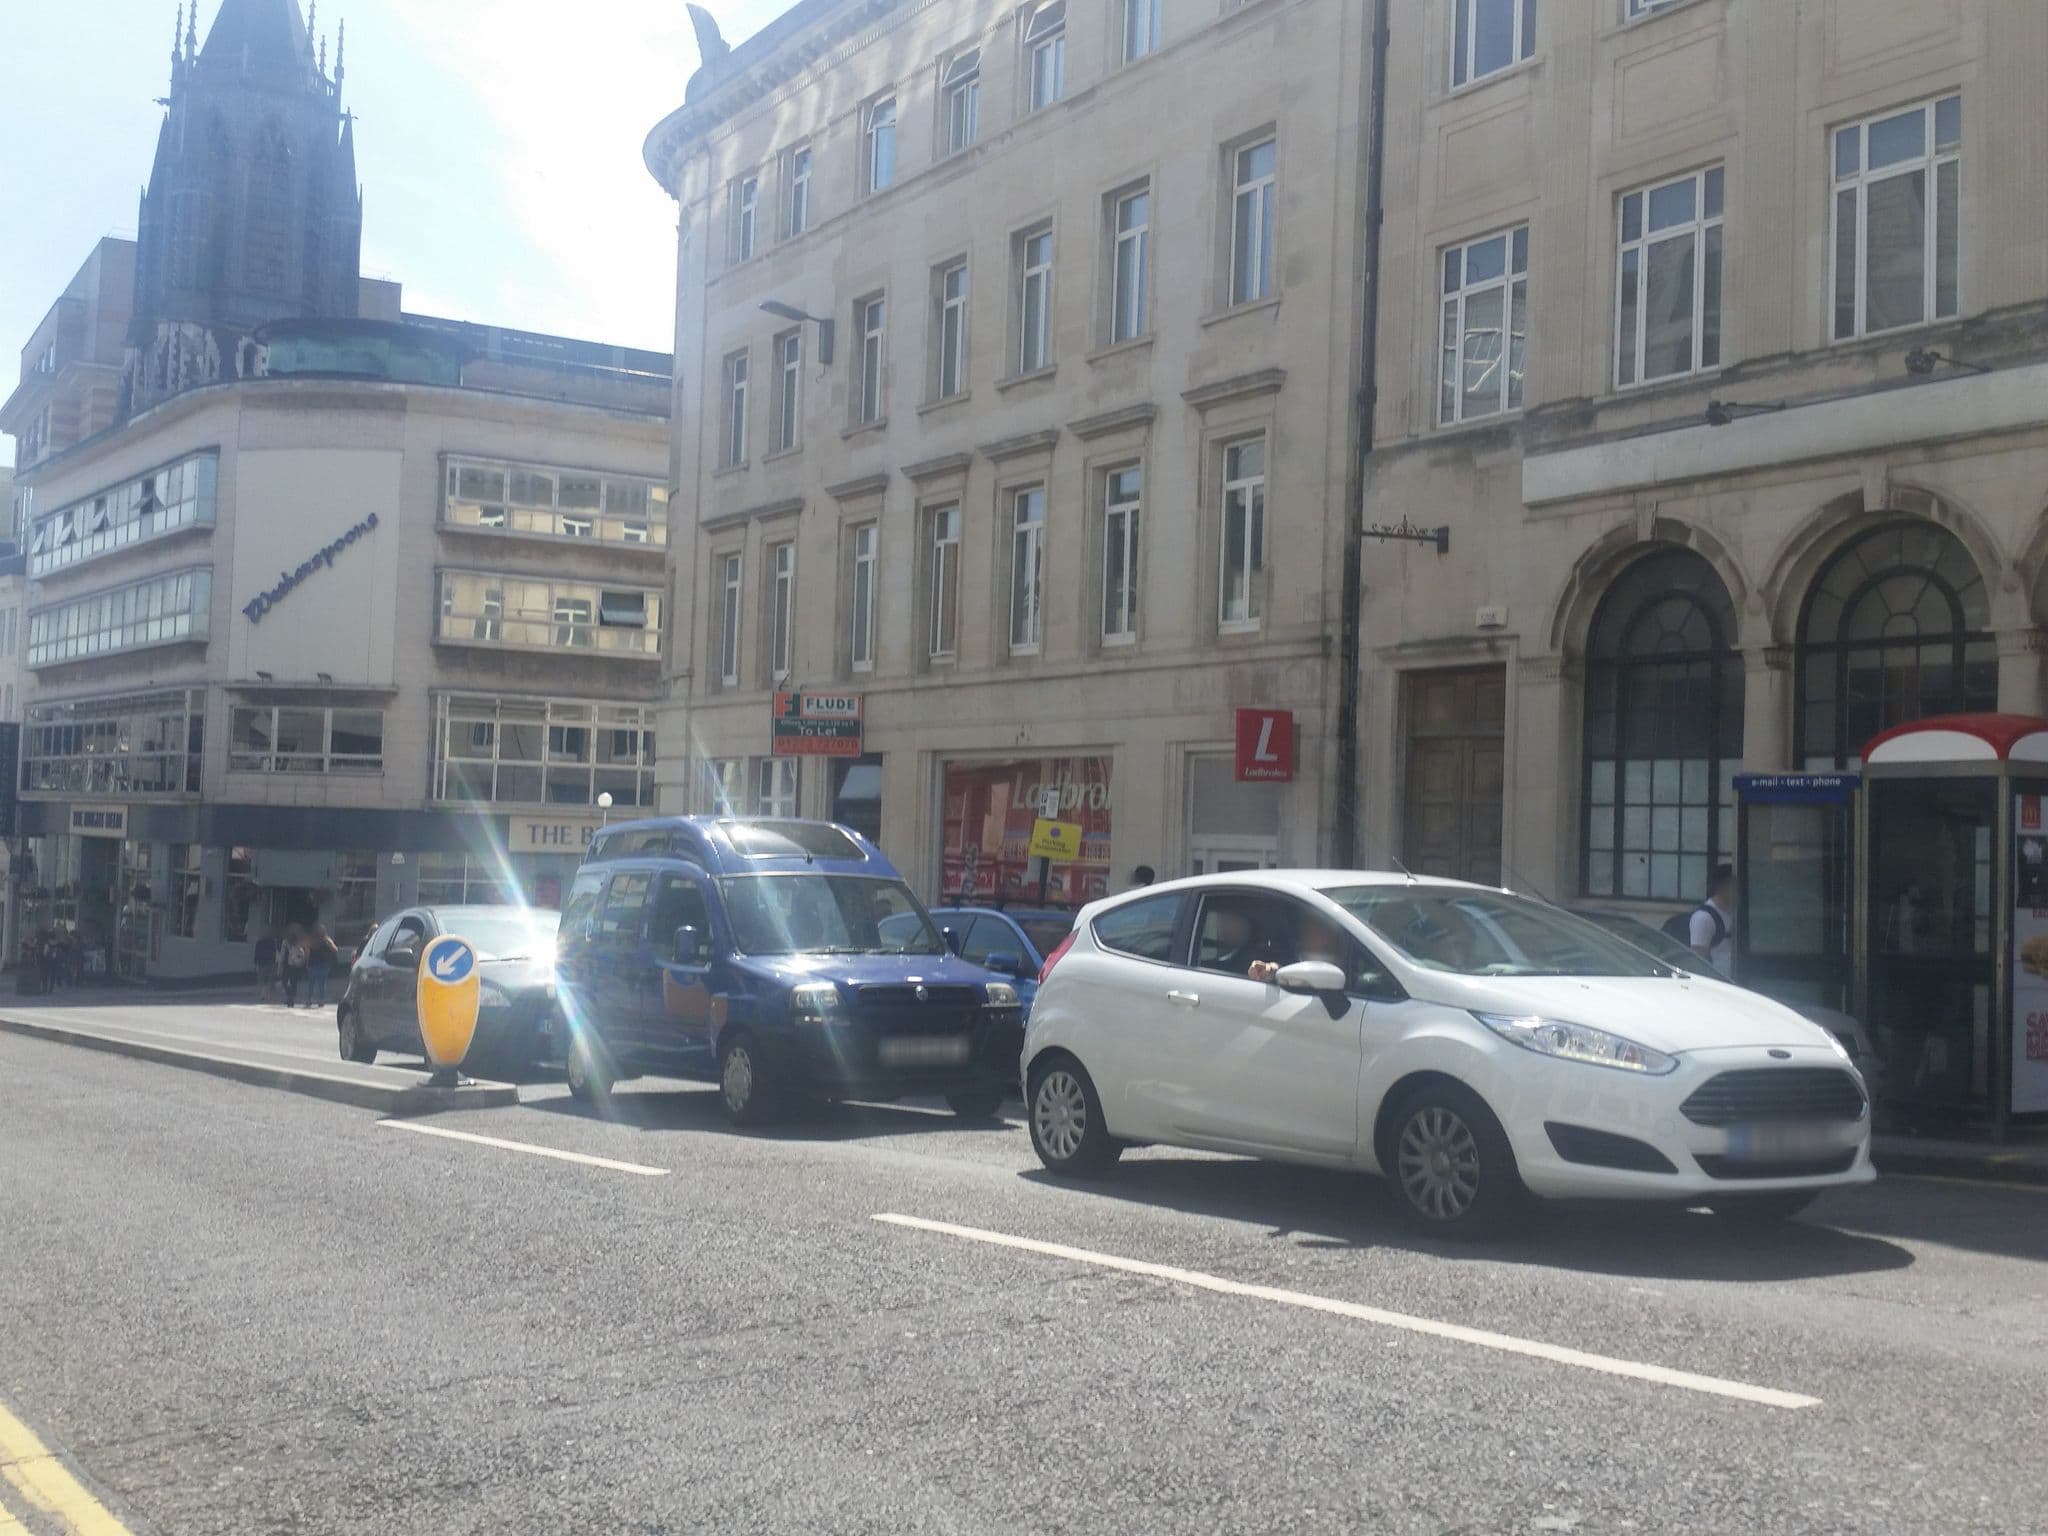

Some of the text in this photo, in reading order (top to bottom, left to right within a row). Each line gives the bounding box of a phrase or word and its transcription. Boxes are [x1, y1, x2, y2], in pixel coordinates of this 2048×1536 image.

[806, 697, 856, 711] FLUDE
[800, 726, 837, 736] To Let
[1255, 716, 1278, 761] L
[1012, 767, 1113, 810] Labro
[1751, 776, 1841, 788] e-mail text phone
[526, 823, 572, 845] THE
